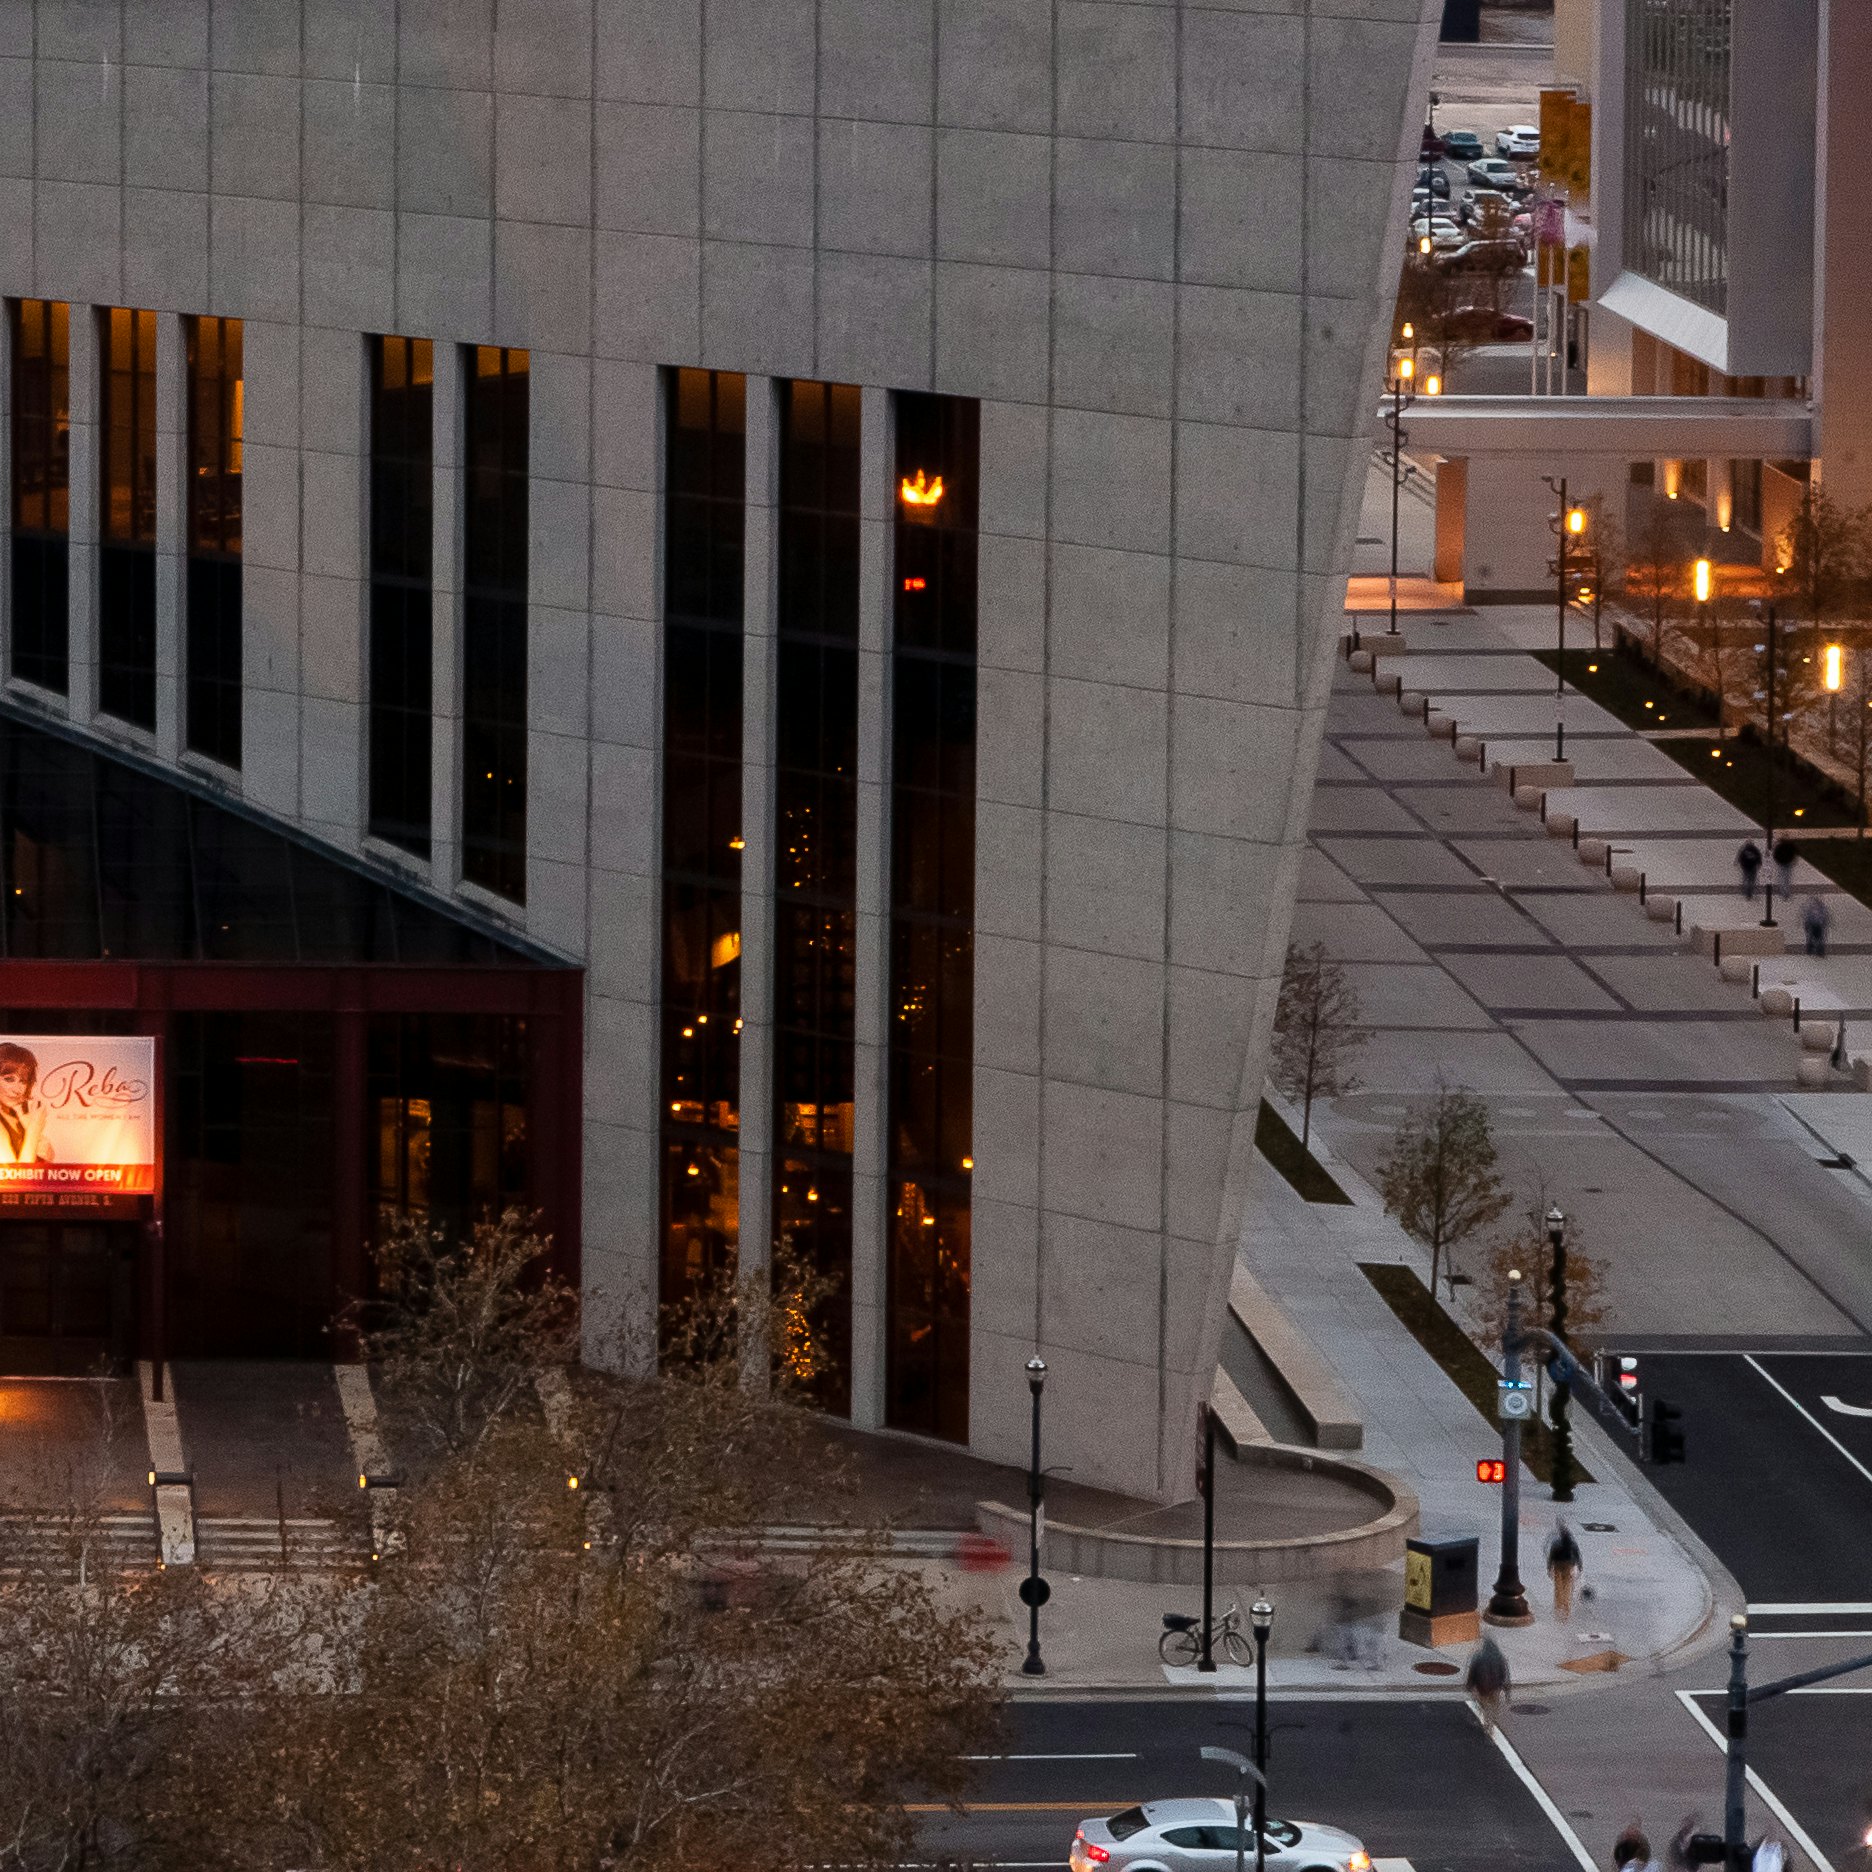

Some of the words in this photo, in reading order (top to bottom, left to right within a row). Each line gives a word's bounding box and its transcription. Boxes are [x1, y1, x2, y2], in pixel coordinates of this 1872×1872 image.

[40, 1060, 150, 1109] Reba
[47, 1169, 82, 1181] NOW
[85, 1169, 123, 1182] OPEN
